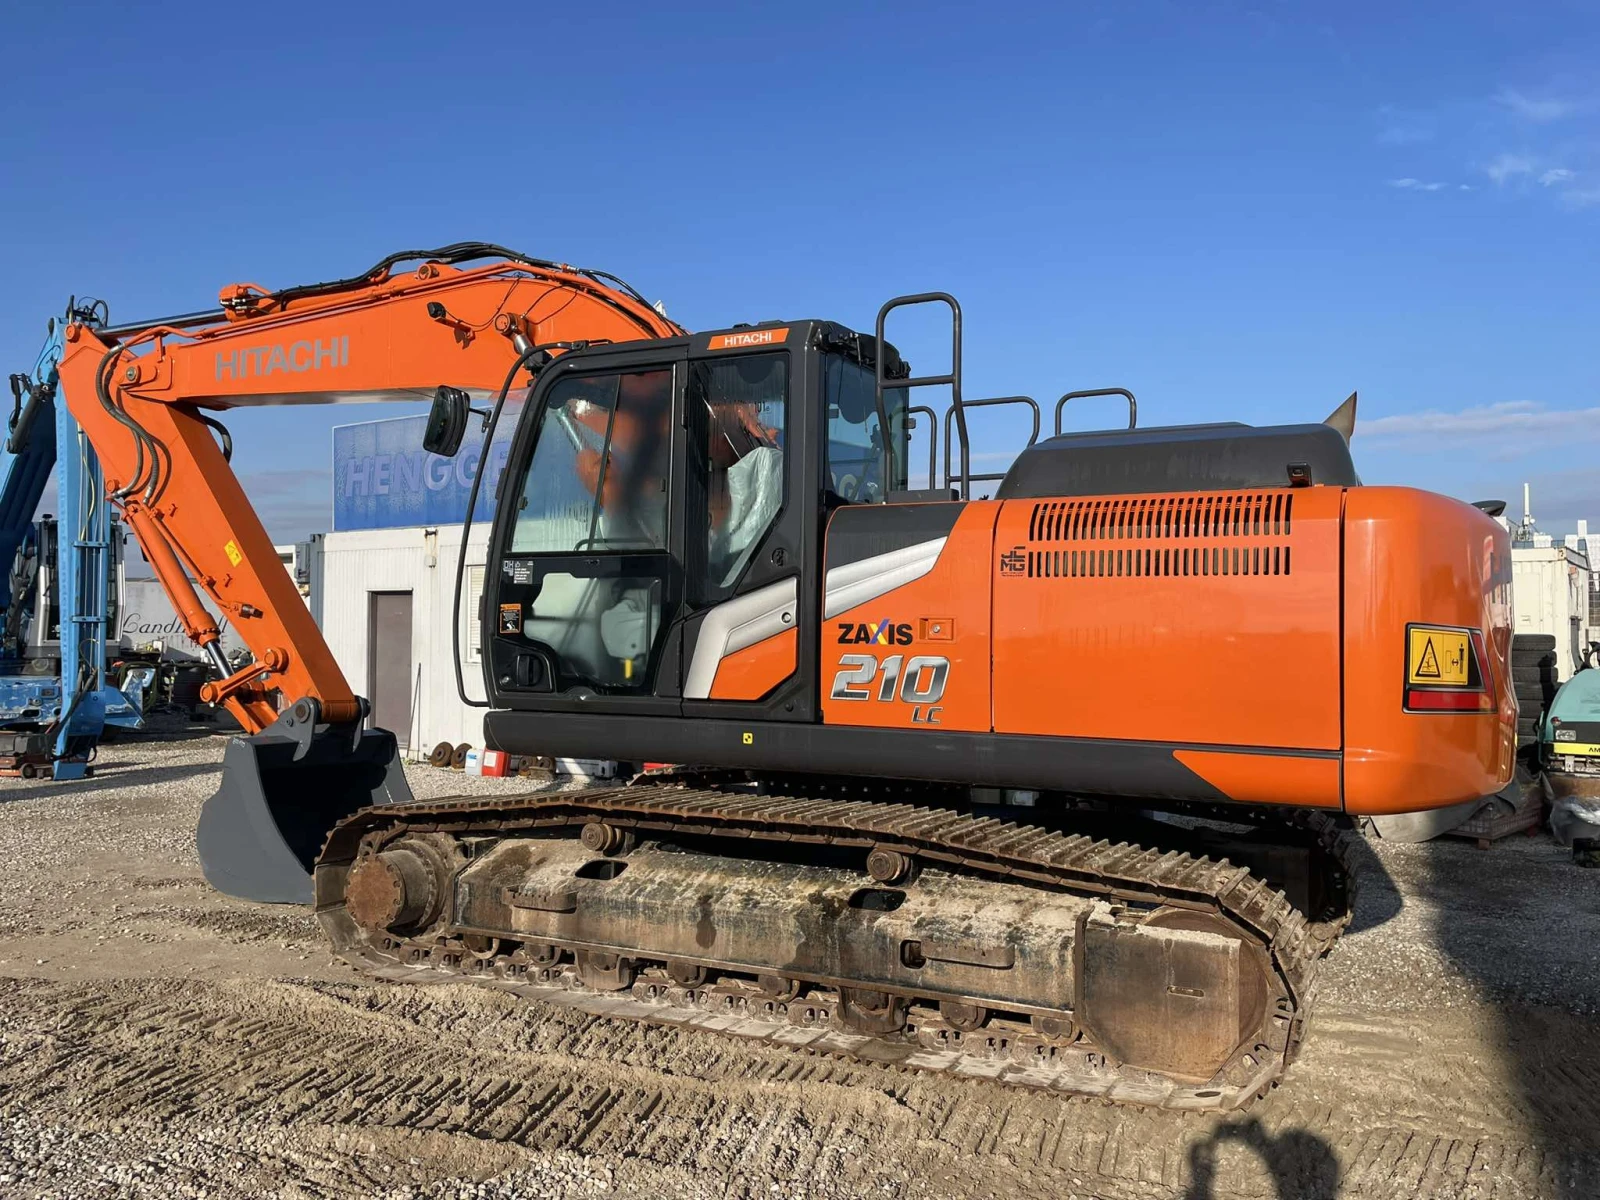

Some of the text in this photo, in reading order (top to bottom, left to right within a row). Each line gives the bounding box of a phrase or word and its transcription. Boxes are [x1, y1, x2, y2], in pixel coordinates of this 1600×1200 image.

[724, 332, 772, 346] HITACHI
[215, 335, 349, 382] HITACHI
[837, 618, 913, 646] ZAXIS
[830, 653, 950, 704] 210
[911, 705, 944, 724] LC
